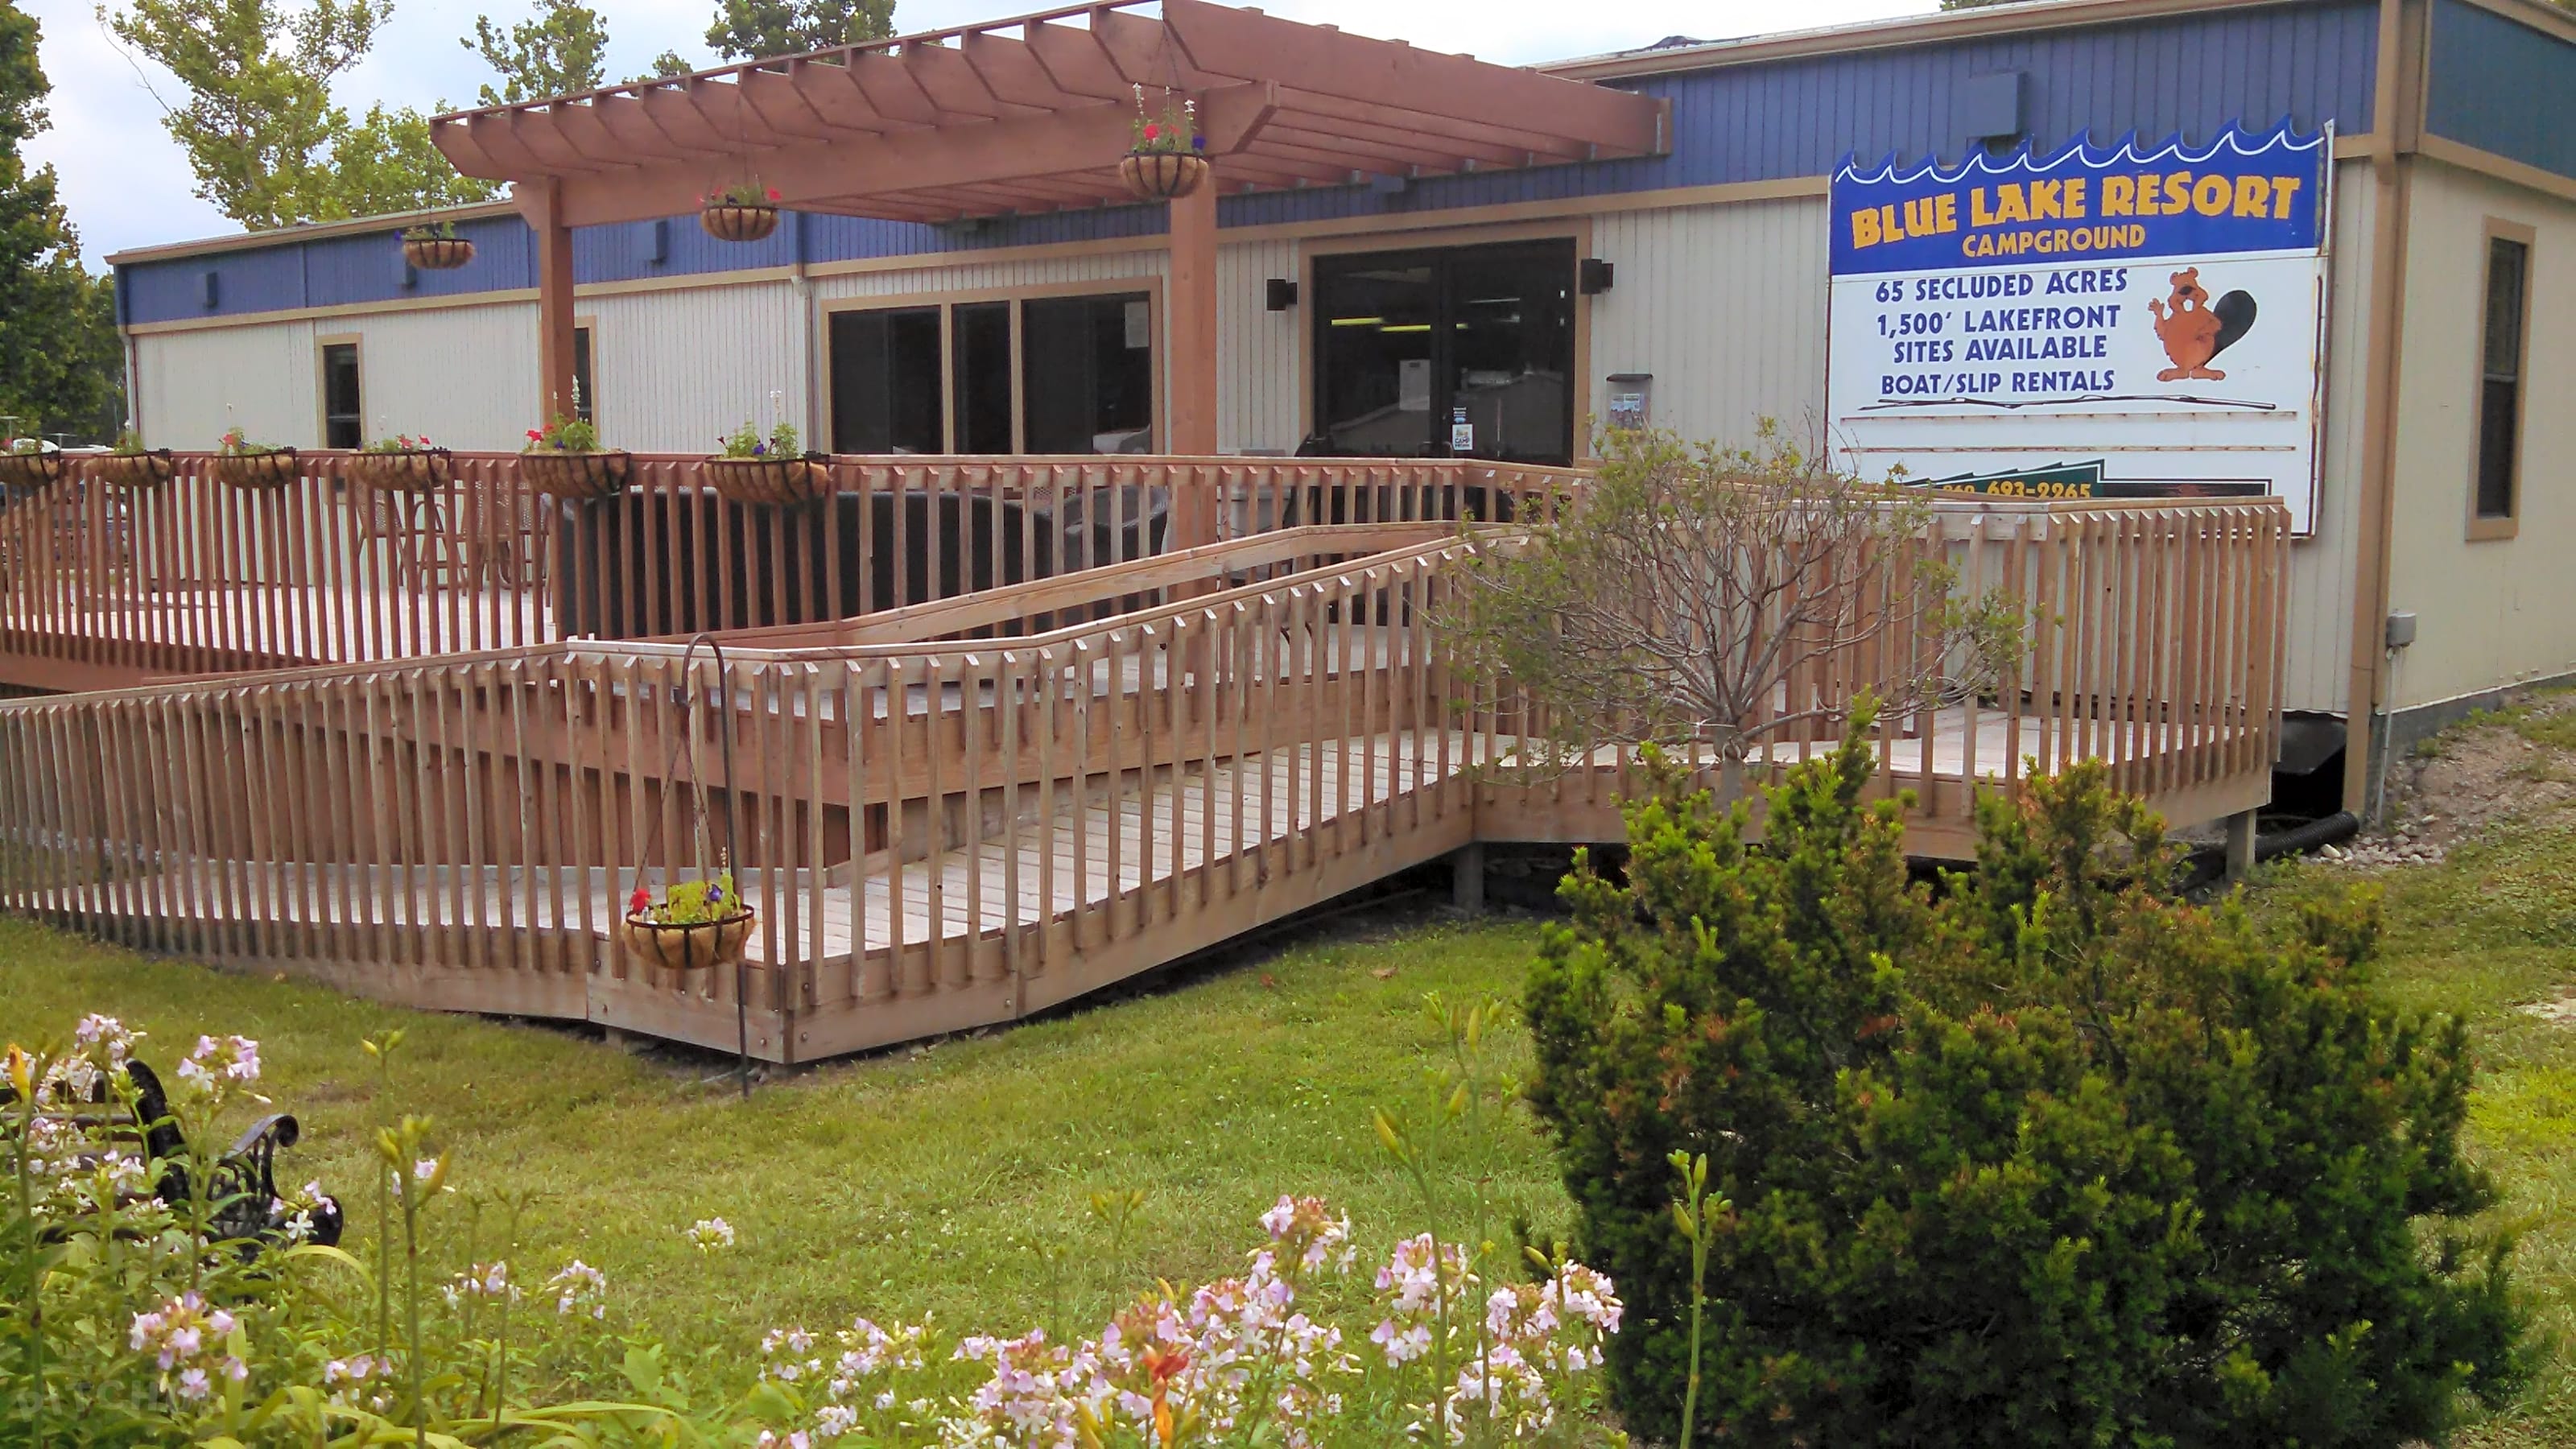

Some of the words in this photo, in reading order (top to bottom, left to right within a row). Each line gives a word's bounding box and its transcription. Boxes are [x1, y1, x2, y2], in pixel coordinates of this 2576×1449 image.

[1852, 193, 1957, 249] BLUE
[1970, 178, 2086, 227] LAKE
[2101, 171, 2301, 219] RESORT
[1962, 225, 2146, 258] CAMPGROUND
[1876, 280, 1903, 303] 65
[1915, 274, 2034, 301] SECLUDED
[2045, 268, 2128, 295] ACRES
[1964, 304, 2121, 332] LAKEFRONT
[1893, 340, 1954, 363] SITES
[1964, 335, 2107, 361] AVAILABLE
[1881, 373, 2002, 394] BOAT/SLIP
[2012, 369, 2115, 393] RENTALS
[1987, 481, 2091, 499] 693-2265
